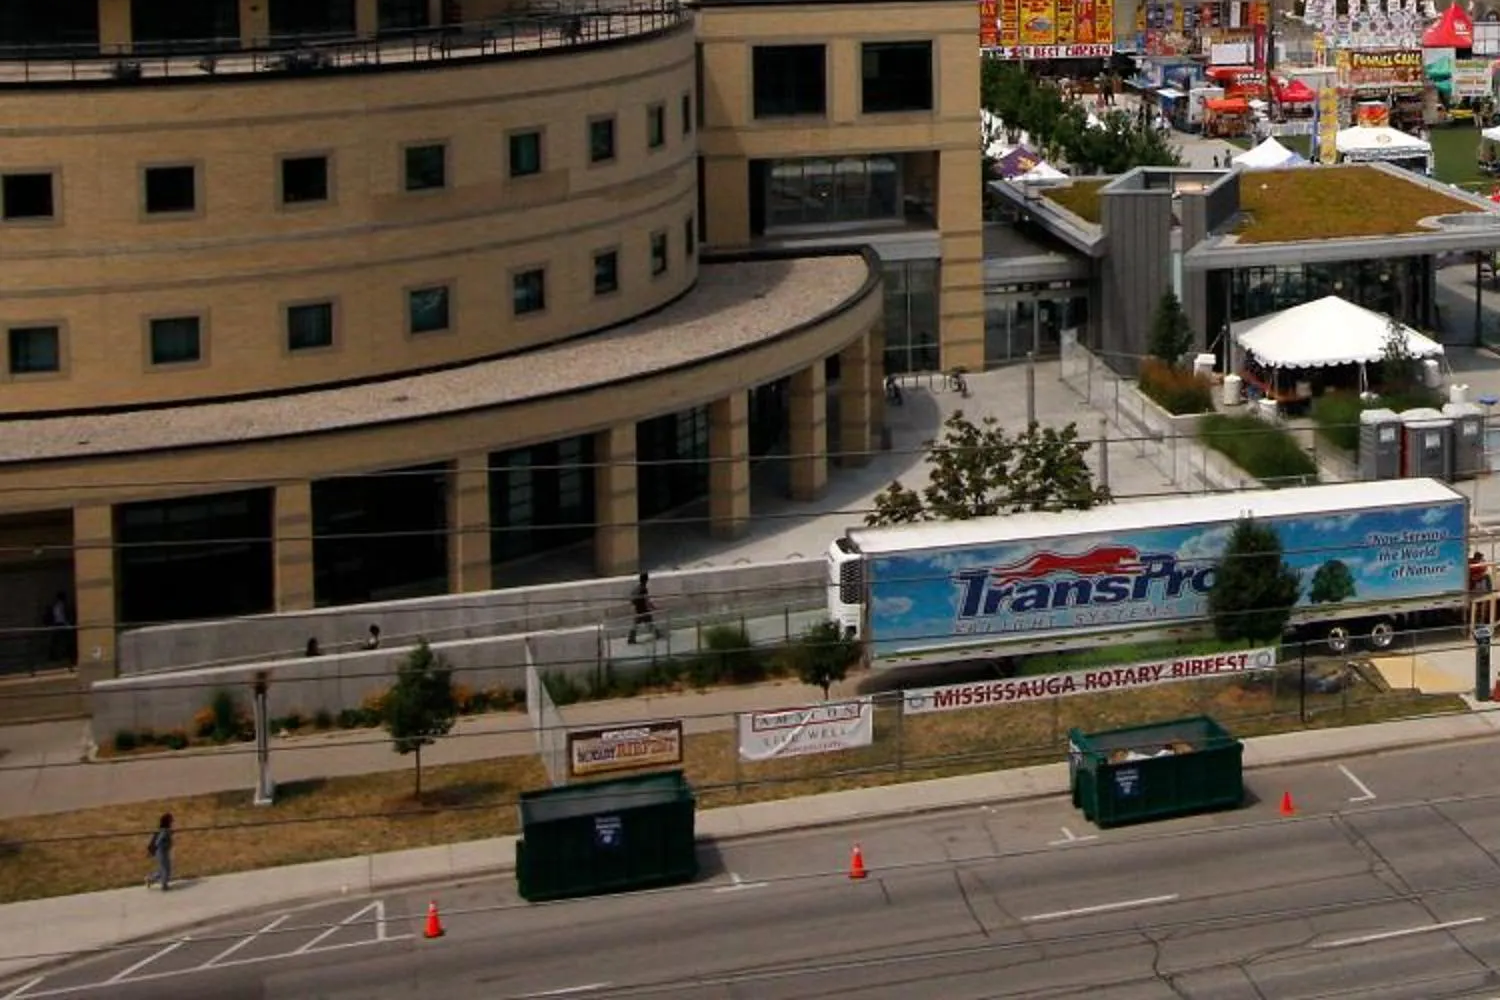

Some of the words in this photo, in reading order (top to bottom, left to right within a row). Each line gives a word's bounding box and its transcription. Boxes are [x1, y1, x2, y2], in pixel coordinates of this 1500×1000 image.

[933, 674, 1076, 708] MISSISSAUGA
[1085, 663, 1164, 691] ROTARY
[1171, 653, 1250, 678] RIBFEST
